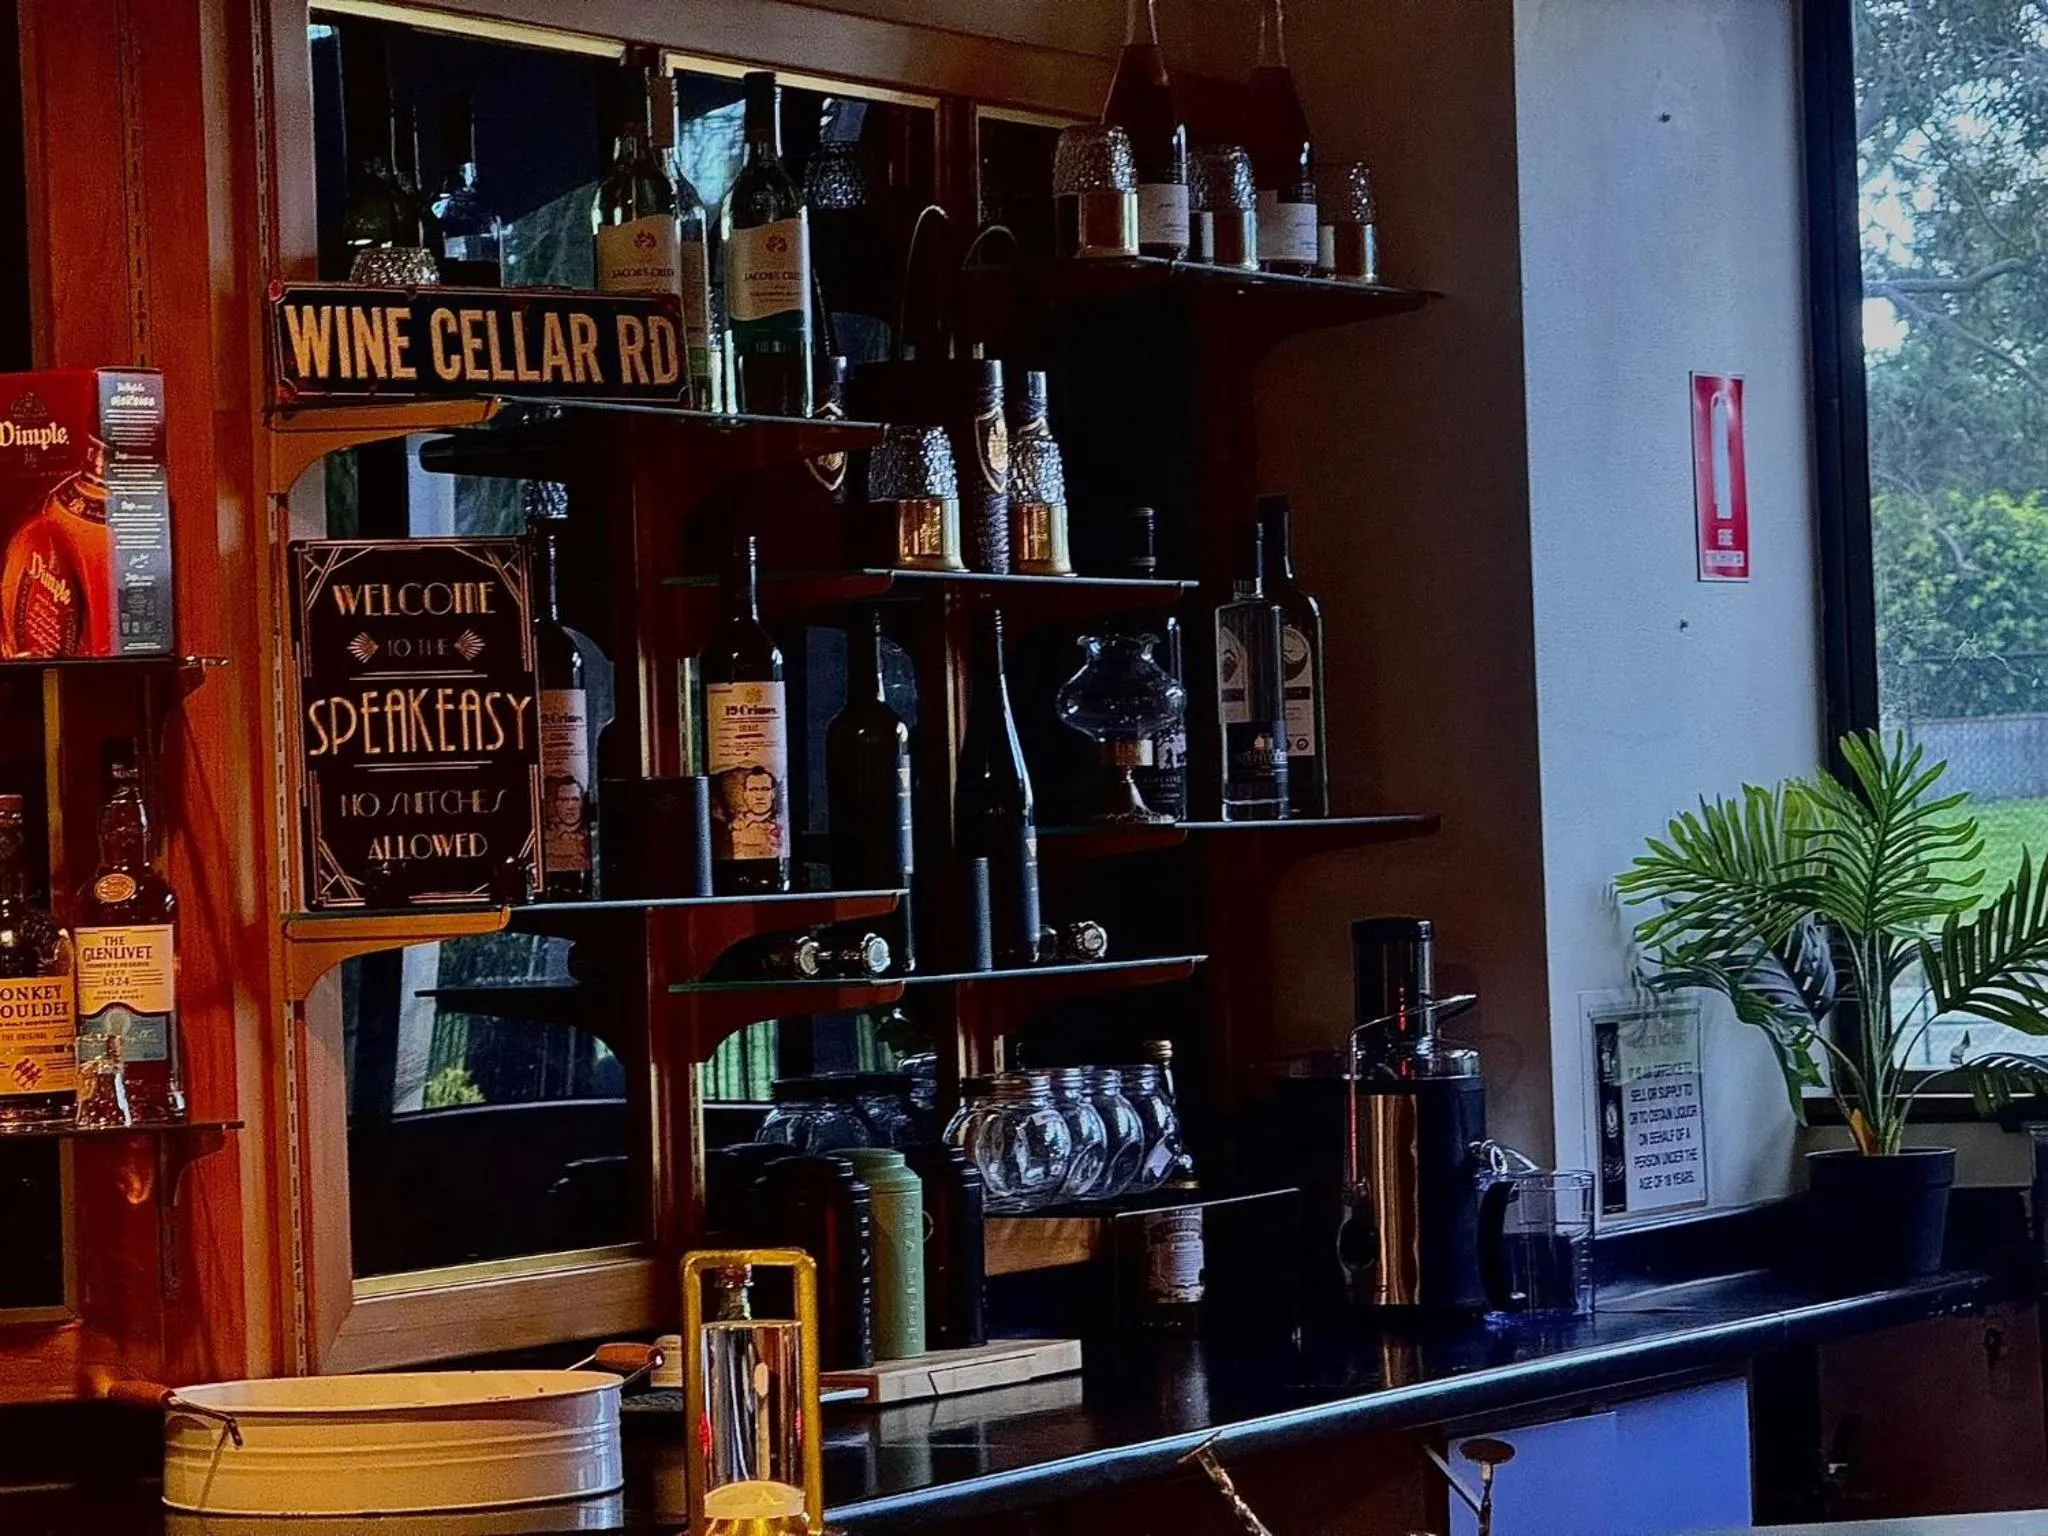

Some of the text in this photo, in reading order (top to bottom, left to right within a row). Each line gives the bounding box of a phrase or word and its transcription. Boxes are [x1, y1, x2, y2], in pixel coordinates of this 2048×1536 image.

[284, 305, 679, 385] WINE CELLAR RD
[332, 582, 497, 617] WELCOME
[387, 638, 449, 657] TO THE
[308, 688, 532, 755] SPEAKEASY
[340, 789, 508, 817] NO SNITCHES
[368, 833, 488, 861] ALLOWED
[83, 946, 152, 962] GLENLIVET
[104, 936, 126, 946] THE
[0, 984, 62, 1001] ONKEY
